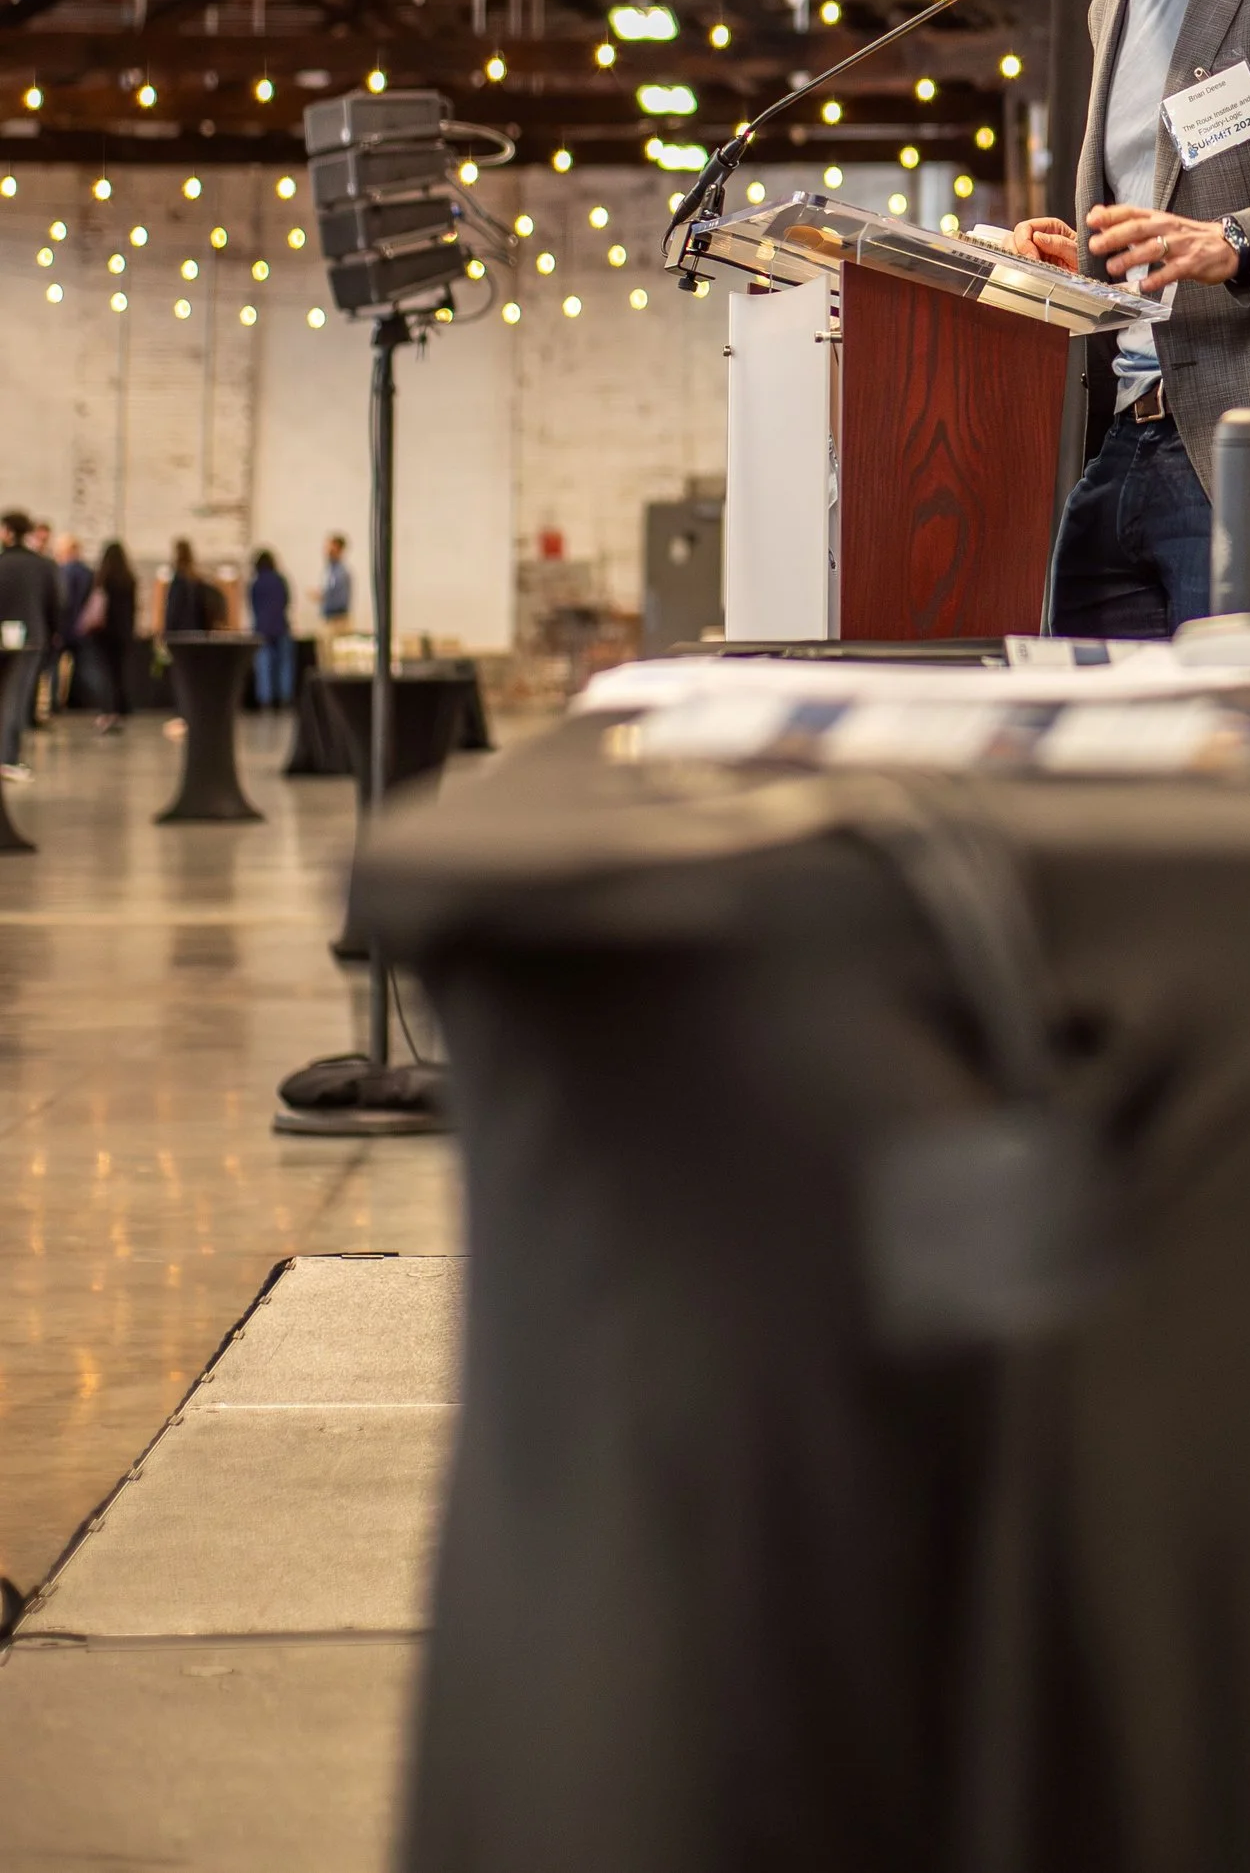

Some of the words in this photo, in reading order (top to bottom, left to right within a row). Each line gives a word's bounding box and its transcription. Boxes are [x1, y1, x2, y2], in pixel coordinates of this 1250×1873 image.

[1187, 90, 1206, 103] Brian
[1205, 80, 1227, 94] Deese
[1182, 122, 1195, 133] The
[1195, 114, 1213, 126] Roux
[1213, 102, 1239, 118] Institute
[1197, 109, 1243, 136] Foundry-Logic
[1192, 127, 1232, 152] SUMMIT
